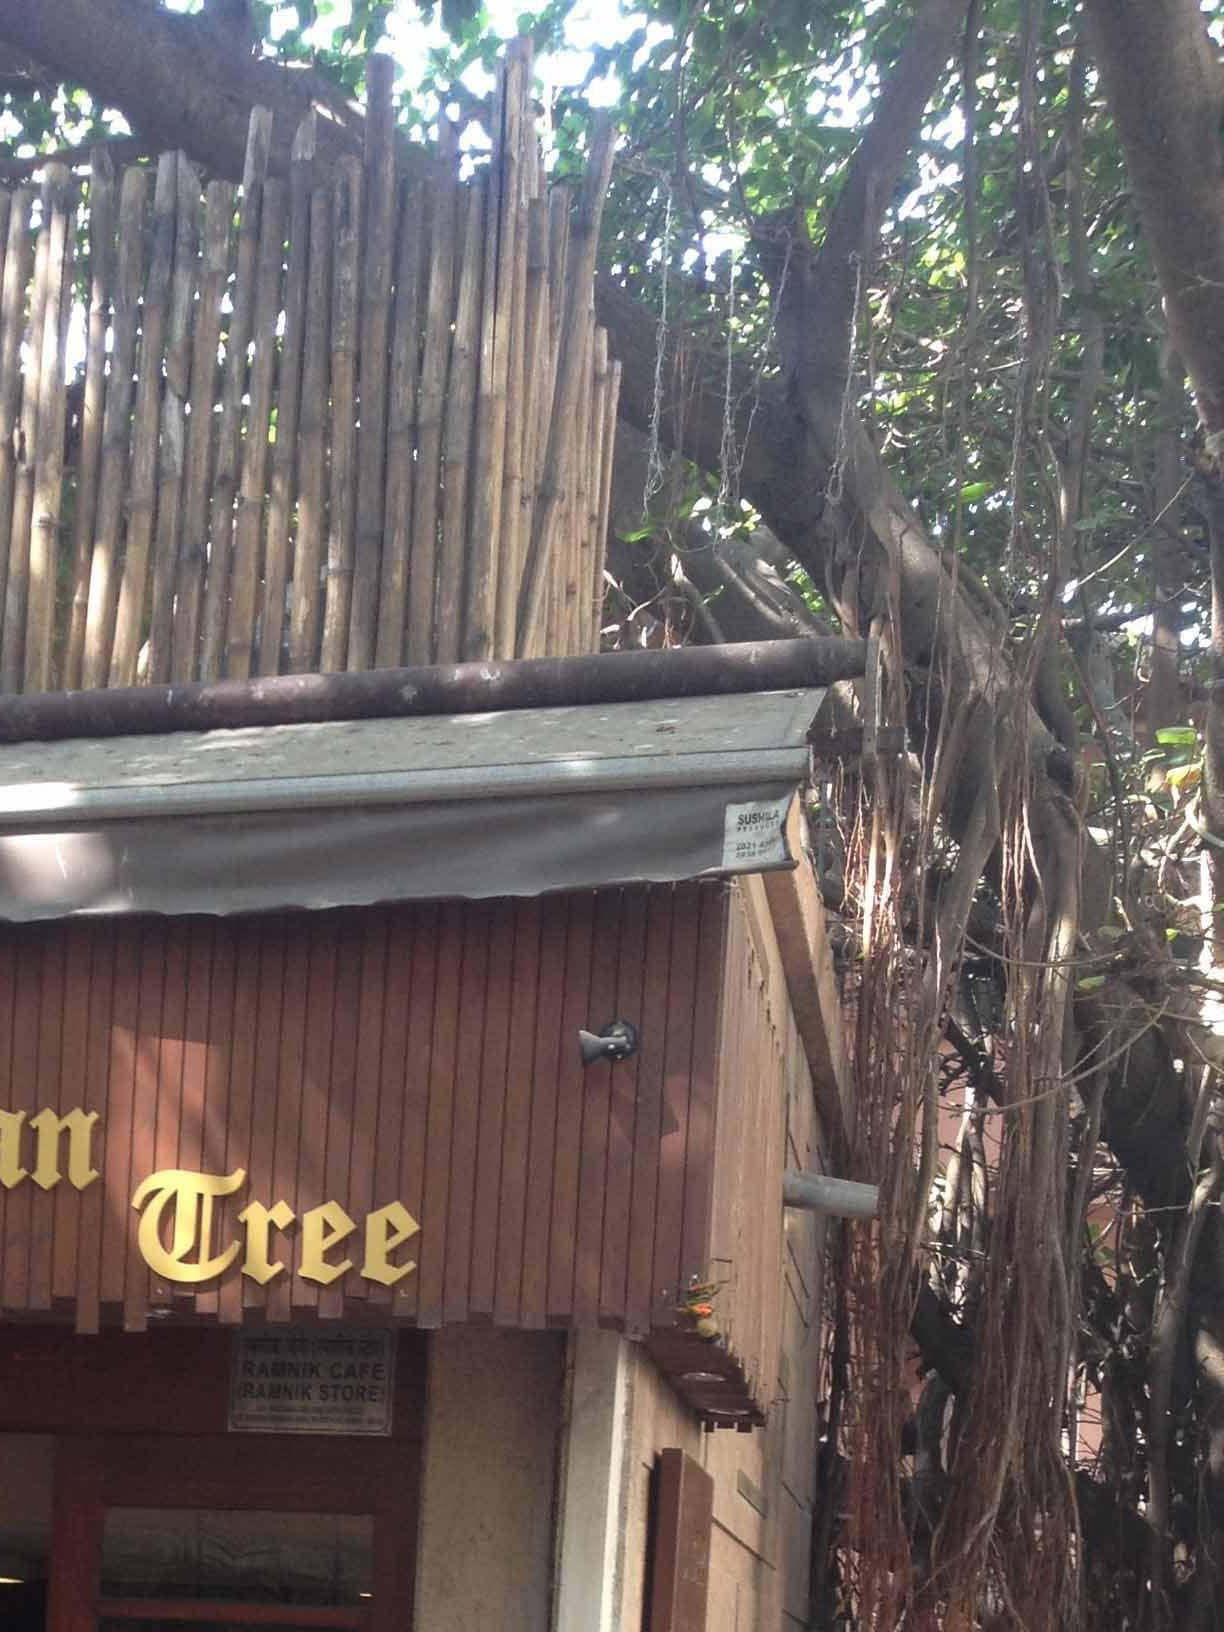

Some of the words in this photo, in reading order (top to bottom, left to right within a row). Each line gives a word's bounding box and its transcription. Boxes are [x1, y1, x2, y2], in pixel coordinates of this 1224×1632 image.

[737, 810, 779, 825] SUSHILA
[131, 1168, 422, 1286] Tree
[242, 1360, 321, 1379] RAMNIK
[329, 1362, 385, 1380] CAFE
